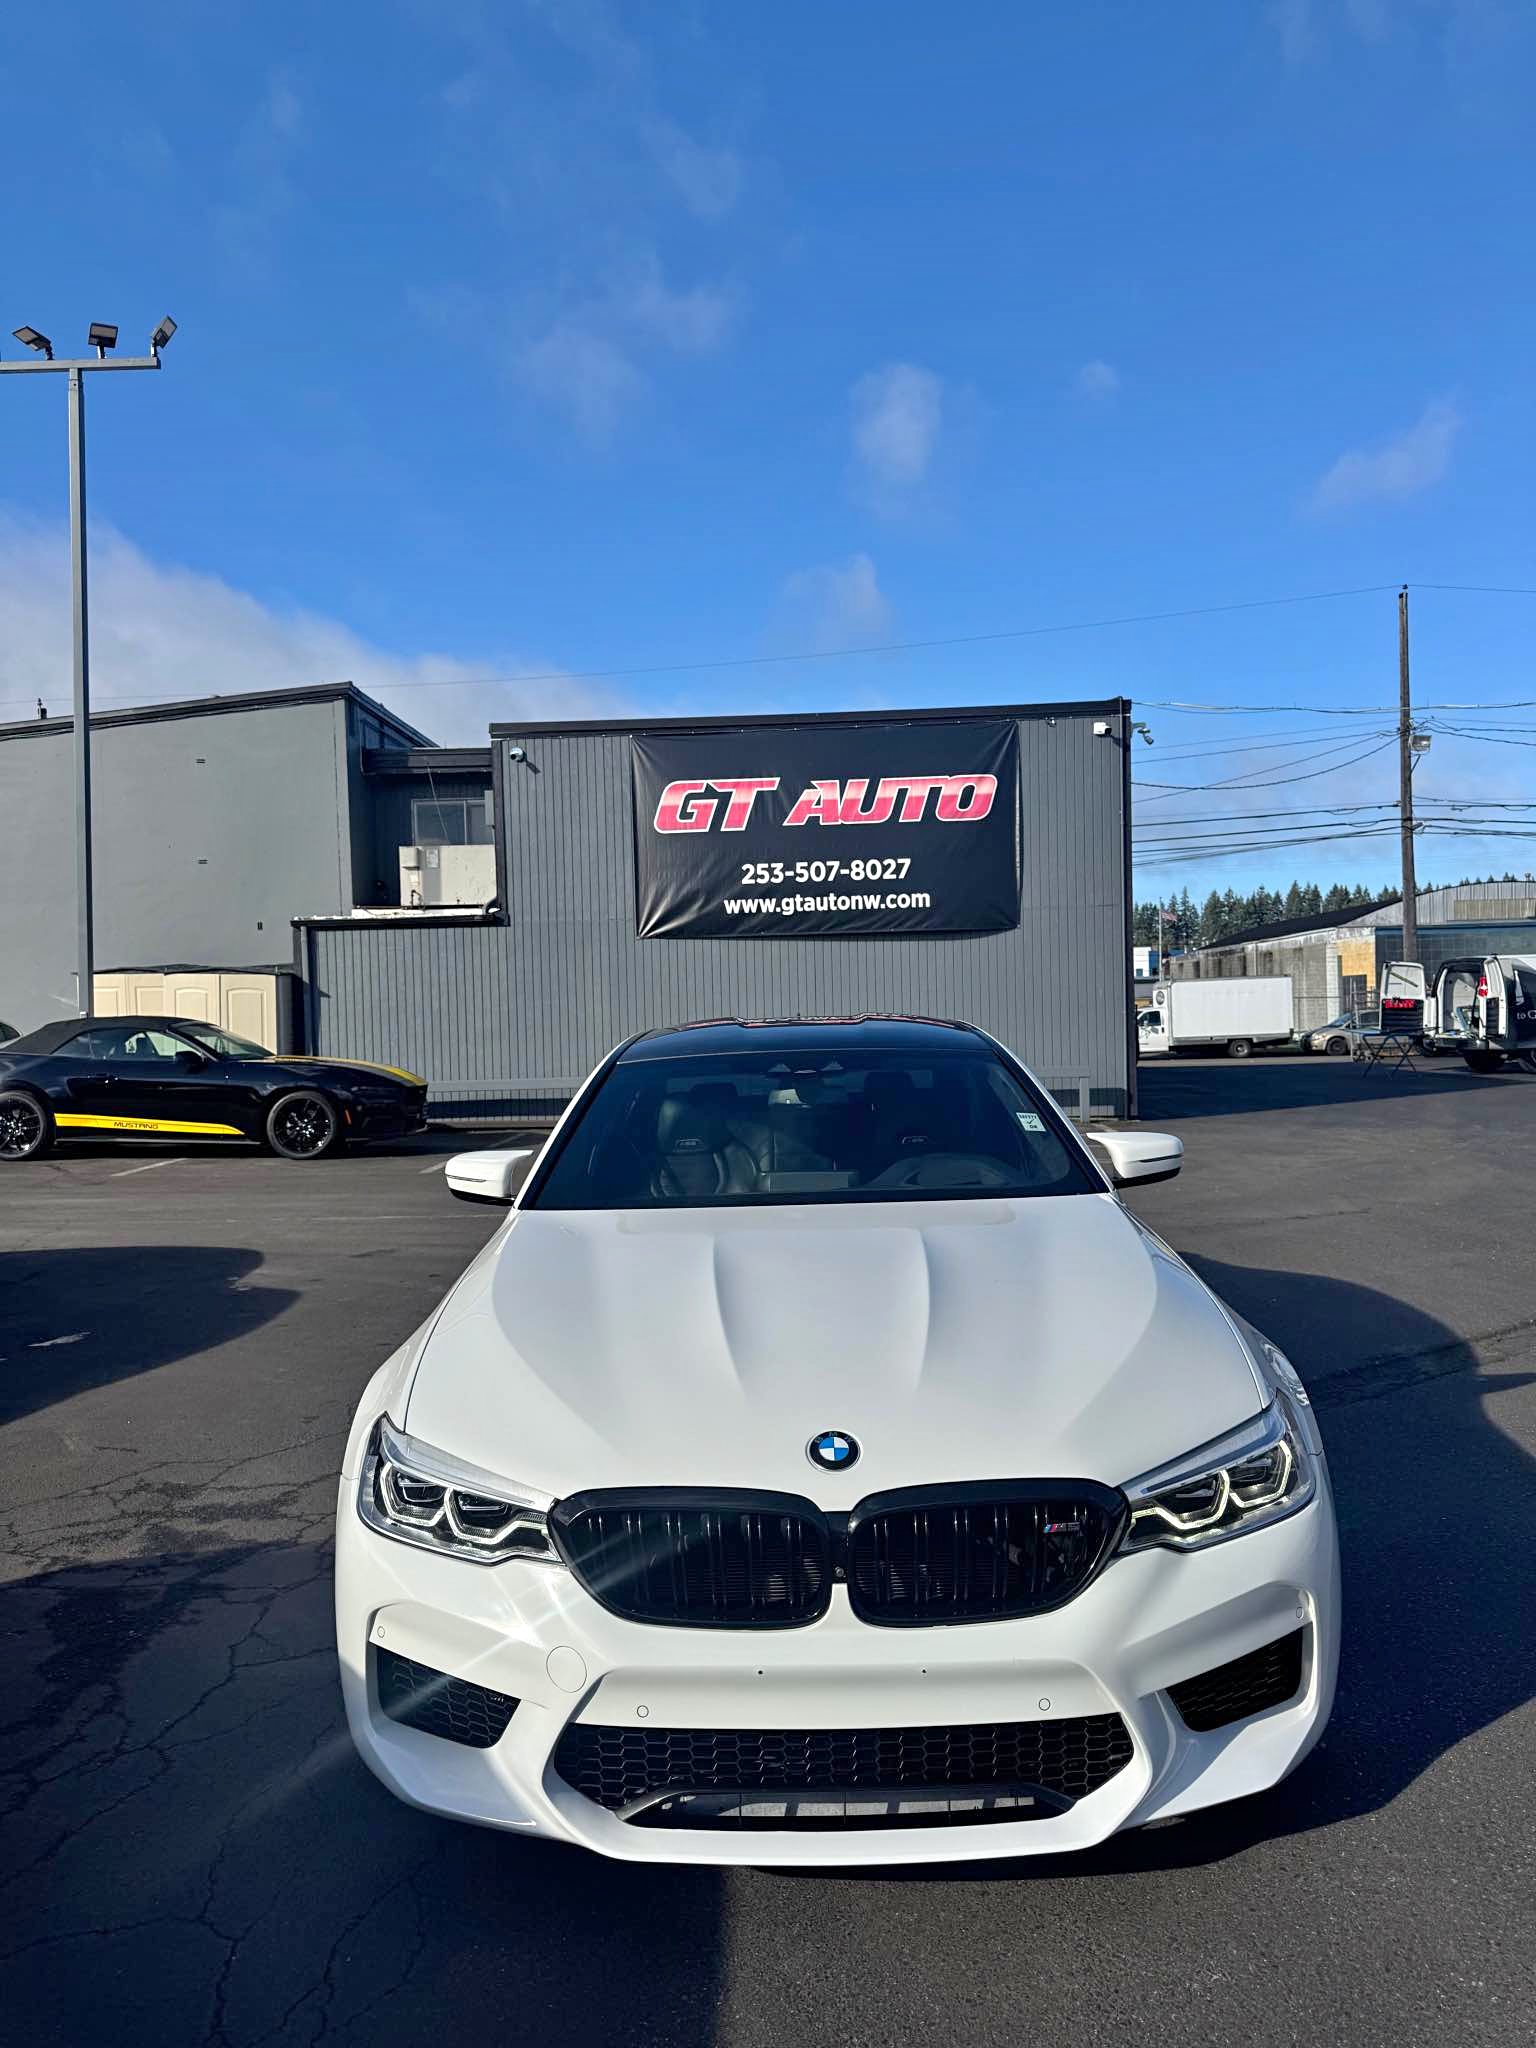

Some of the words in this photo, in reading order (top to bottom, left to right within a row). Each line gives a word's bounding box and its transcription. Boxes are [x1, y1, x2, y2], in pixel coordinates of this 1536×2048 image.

[653, 777, 781, 833] GT
[783, 774, 998, 826] AUTO
[741, 858, 911, 885] 253-507-8027
[724, 891, 931, 916] www.gtautonw.com
[113, 1121, 159, 1129] MUSTANG
